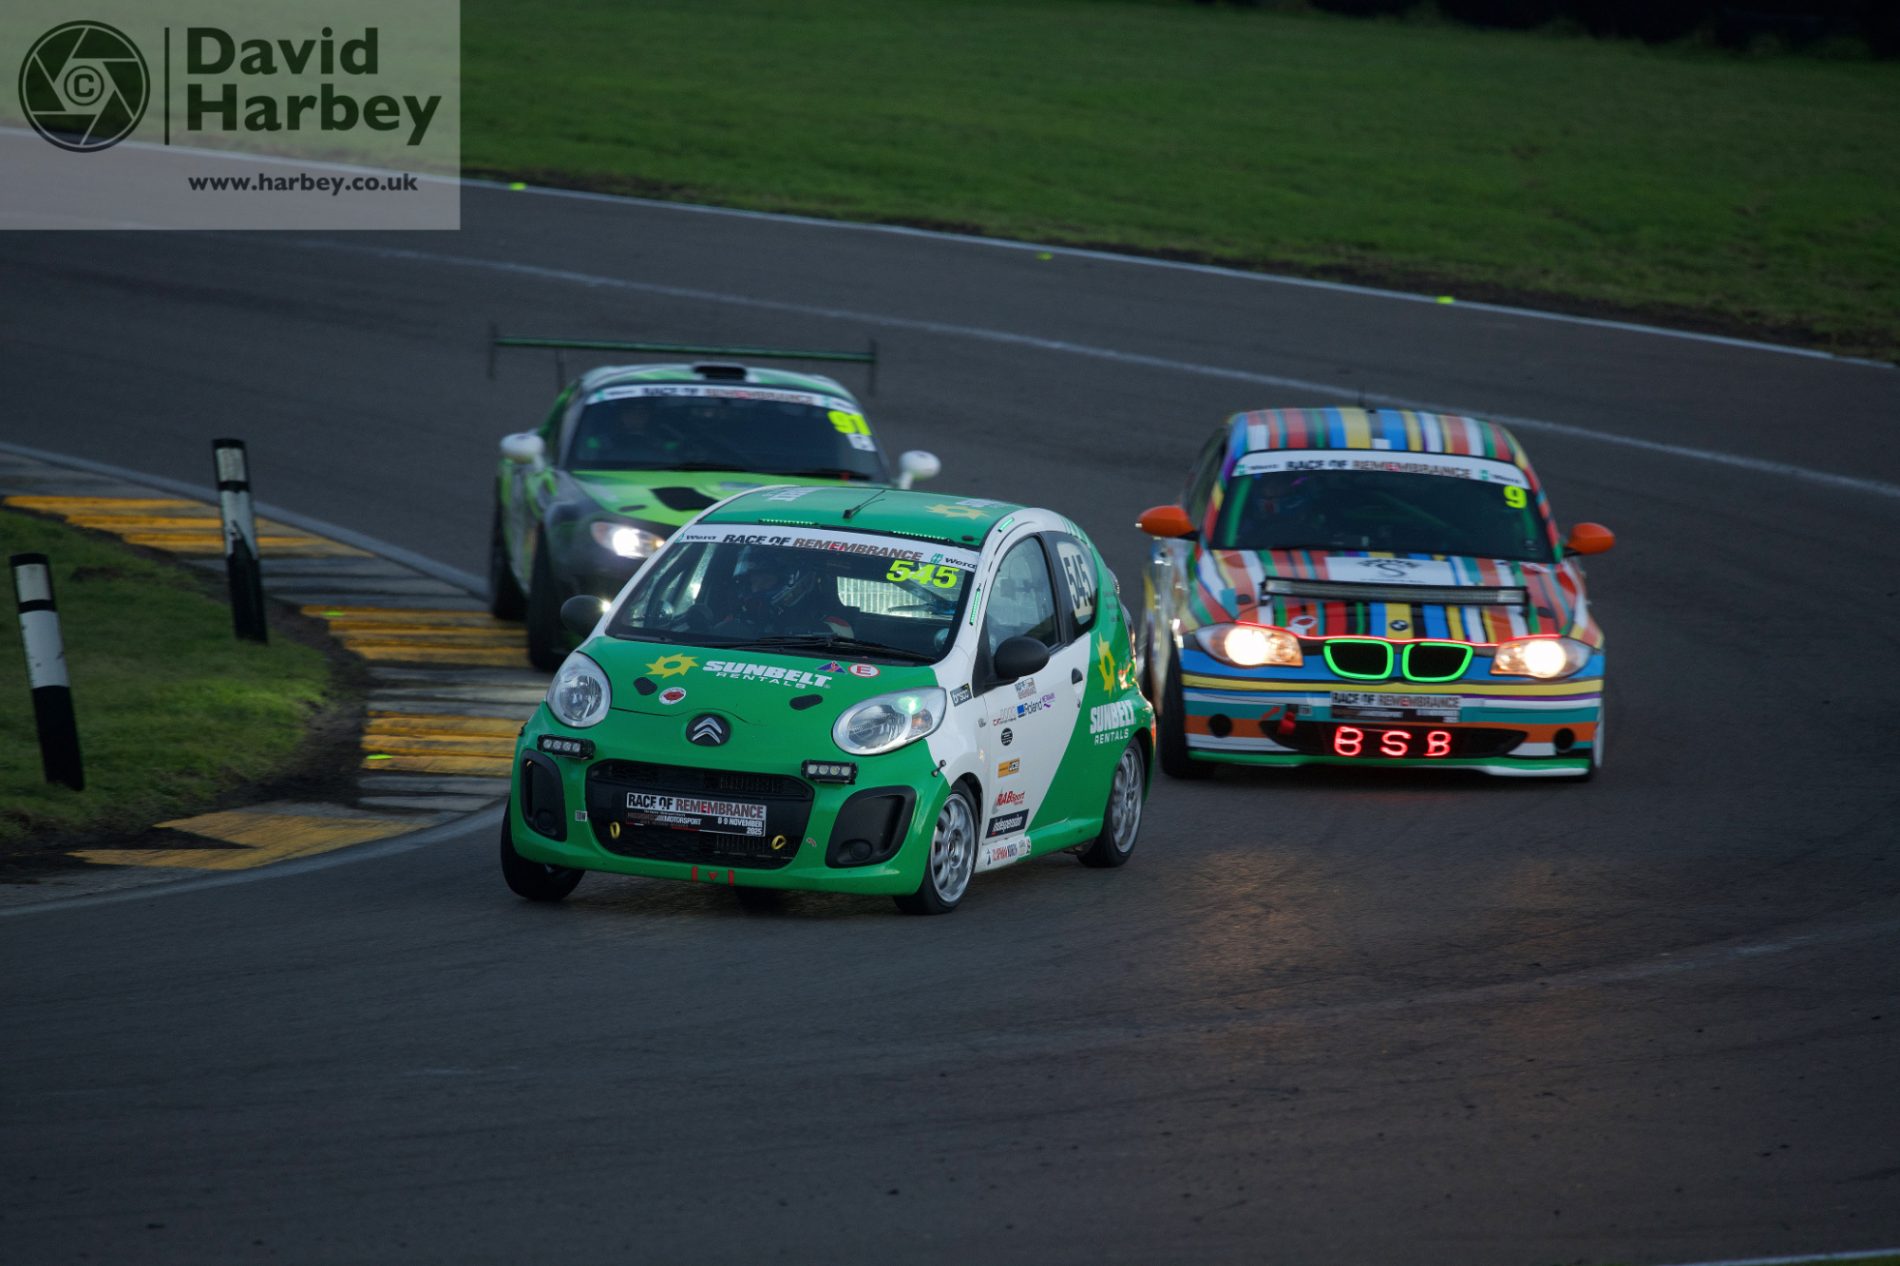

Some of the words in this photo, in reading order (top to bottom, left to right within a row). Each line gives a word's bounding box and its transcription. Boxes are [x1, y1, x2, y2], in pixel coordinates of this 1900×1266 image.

[827, 410, 872, 436] 91
[1503, 485, 1527, 509] 9
[723, 533, 768, 546] RACE
[793, 537, 924, 562] REMEMBRANCE
[885, 559, 961, 589] 545
[703, 661, 832, 687] SUNBELT
[716, 672, 806, 689] RENTALS
[1090, 699, 1135, 735] SUNBELT
[1094, 728, 1129, 746] RENTALS
[628, 793, 657, 808] RACE
[658, 796, 673, 810] OF
[675, 799, 764, 819] REMEMBRANCE
